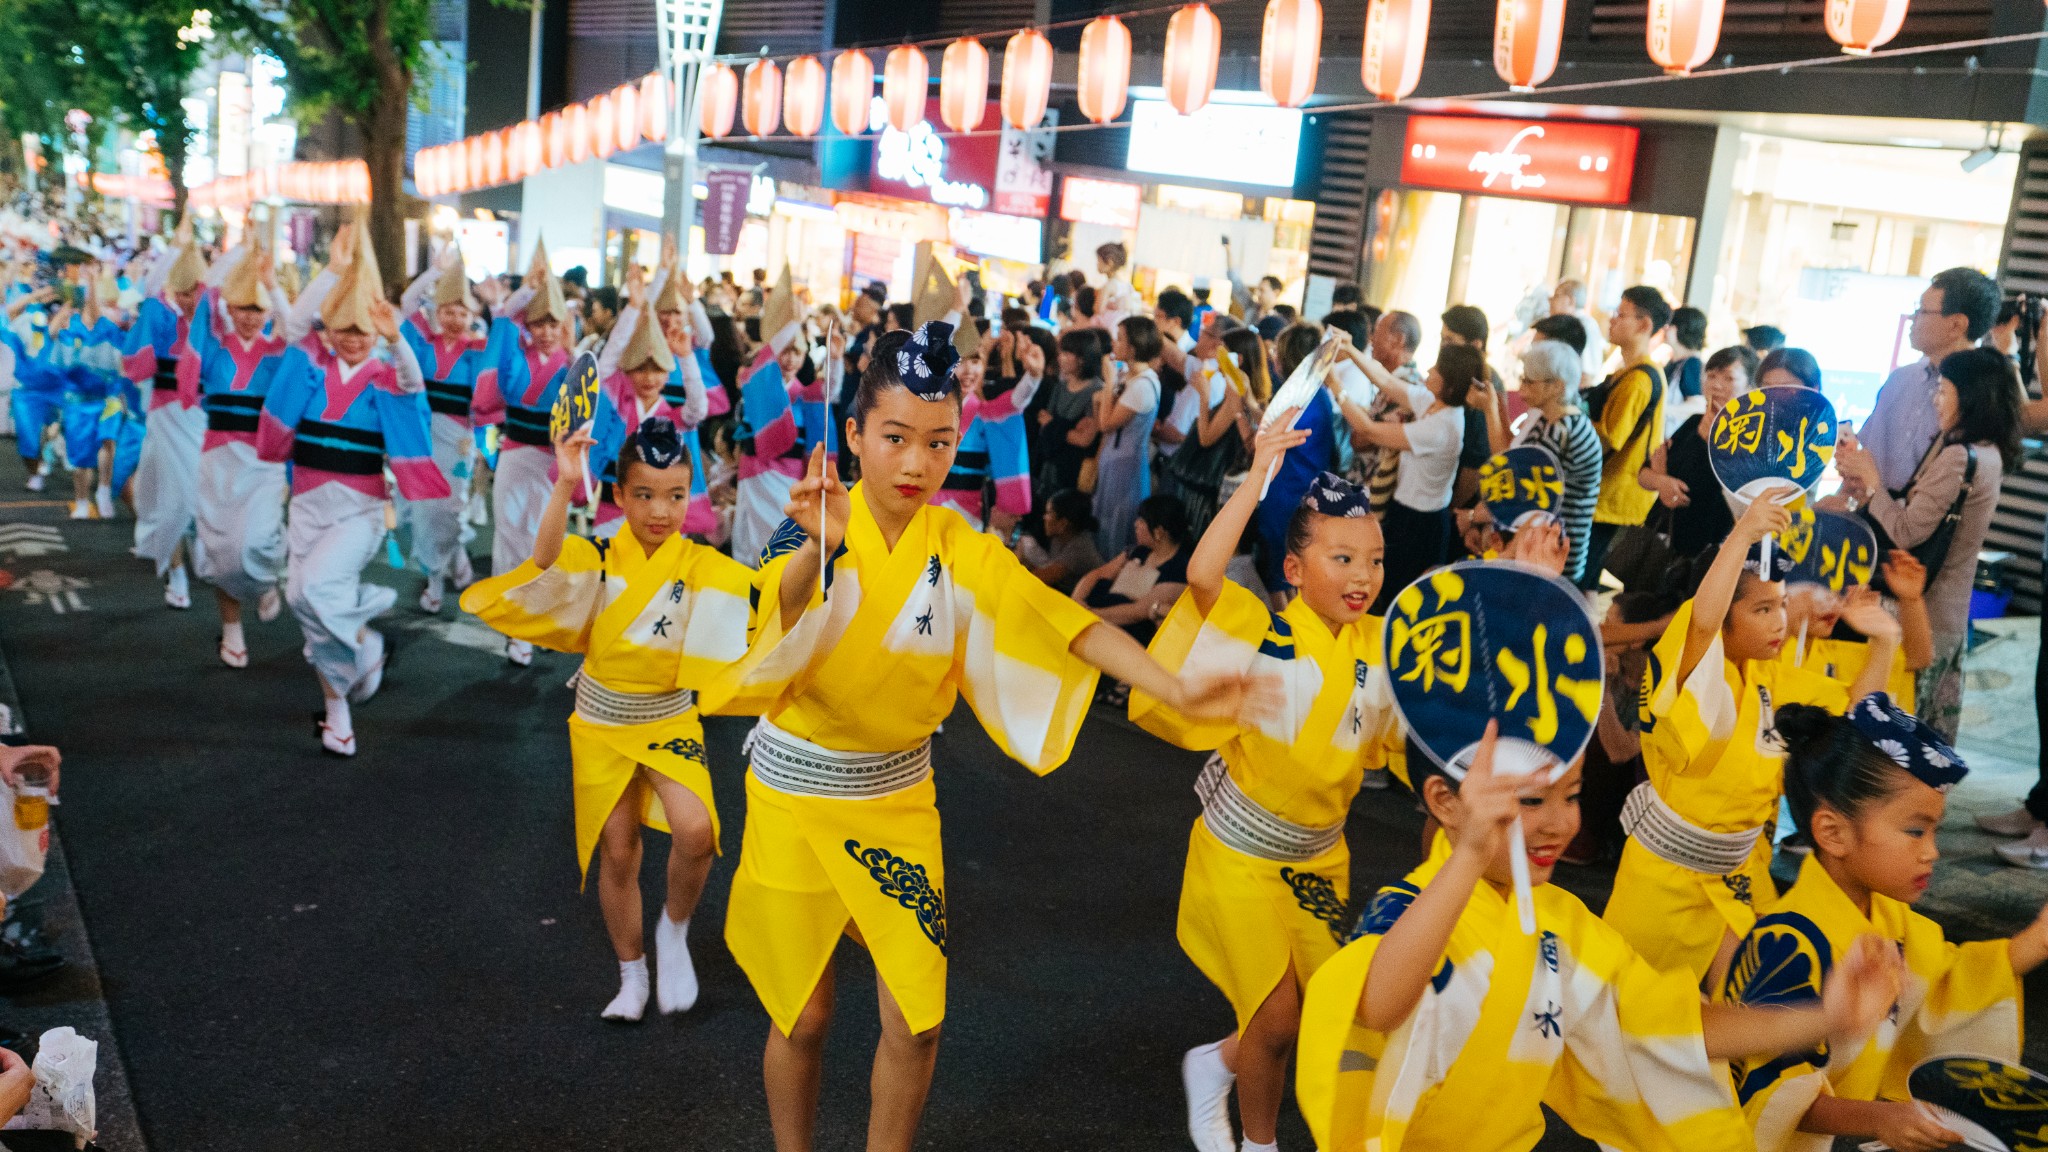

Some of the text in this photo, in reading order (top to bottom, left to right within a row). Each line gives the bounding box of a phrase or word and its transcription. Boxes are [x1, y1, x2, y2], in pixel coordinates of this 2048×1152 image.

[1713, 389, 1836, 478] 菊水
[1479, 455, 1564, 510] 菊水
[913, 553, 943, 636] 菊水
[1390, 569, 1602, 745] 菊水
